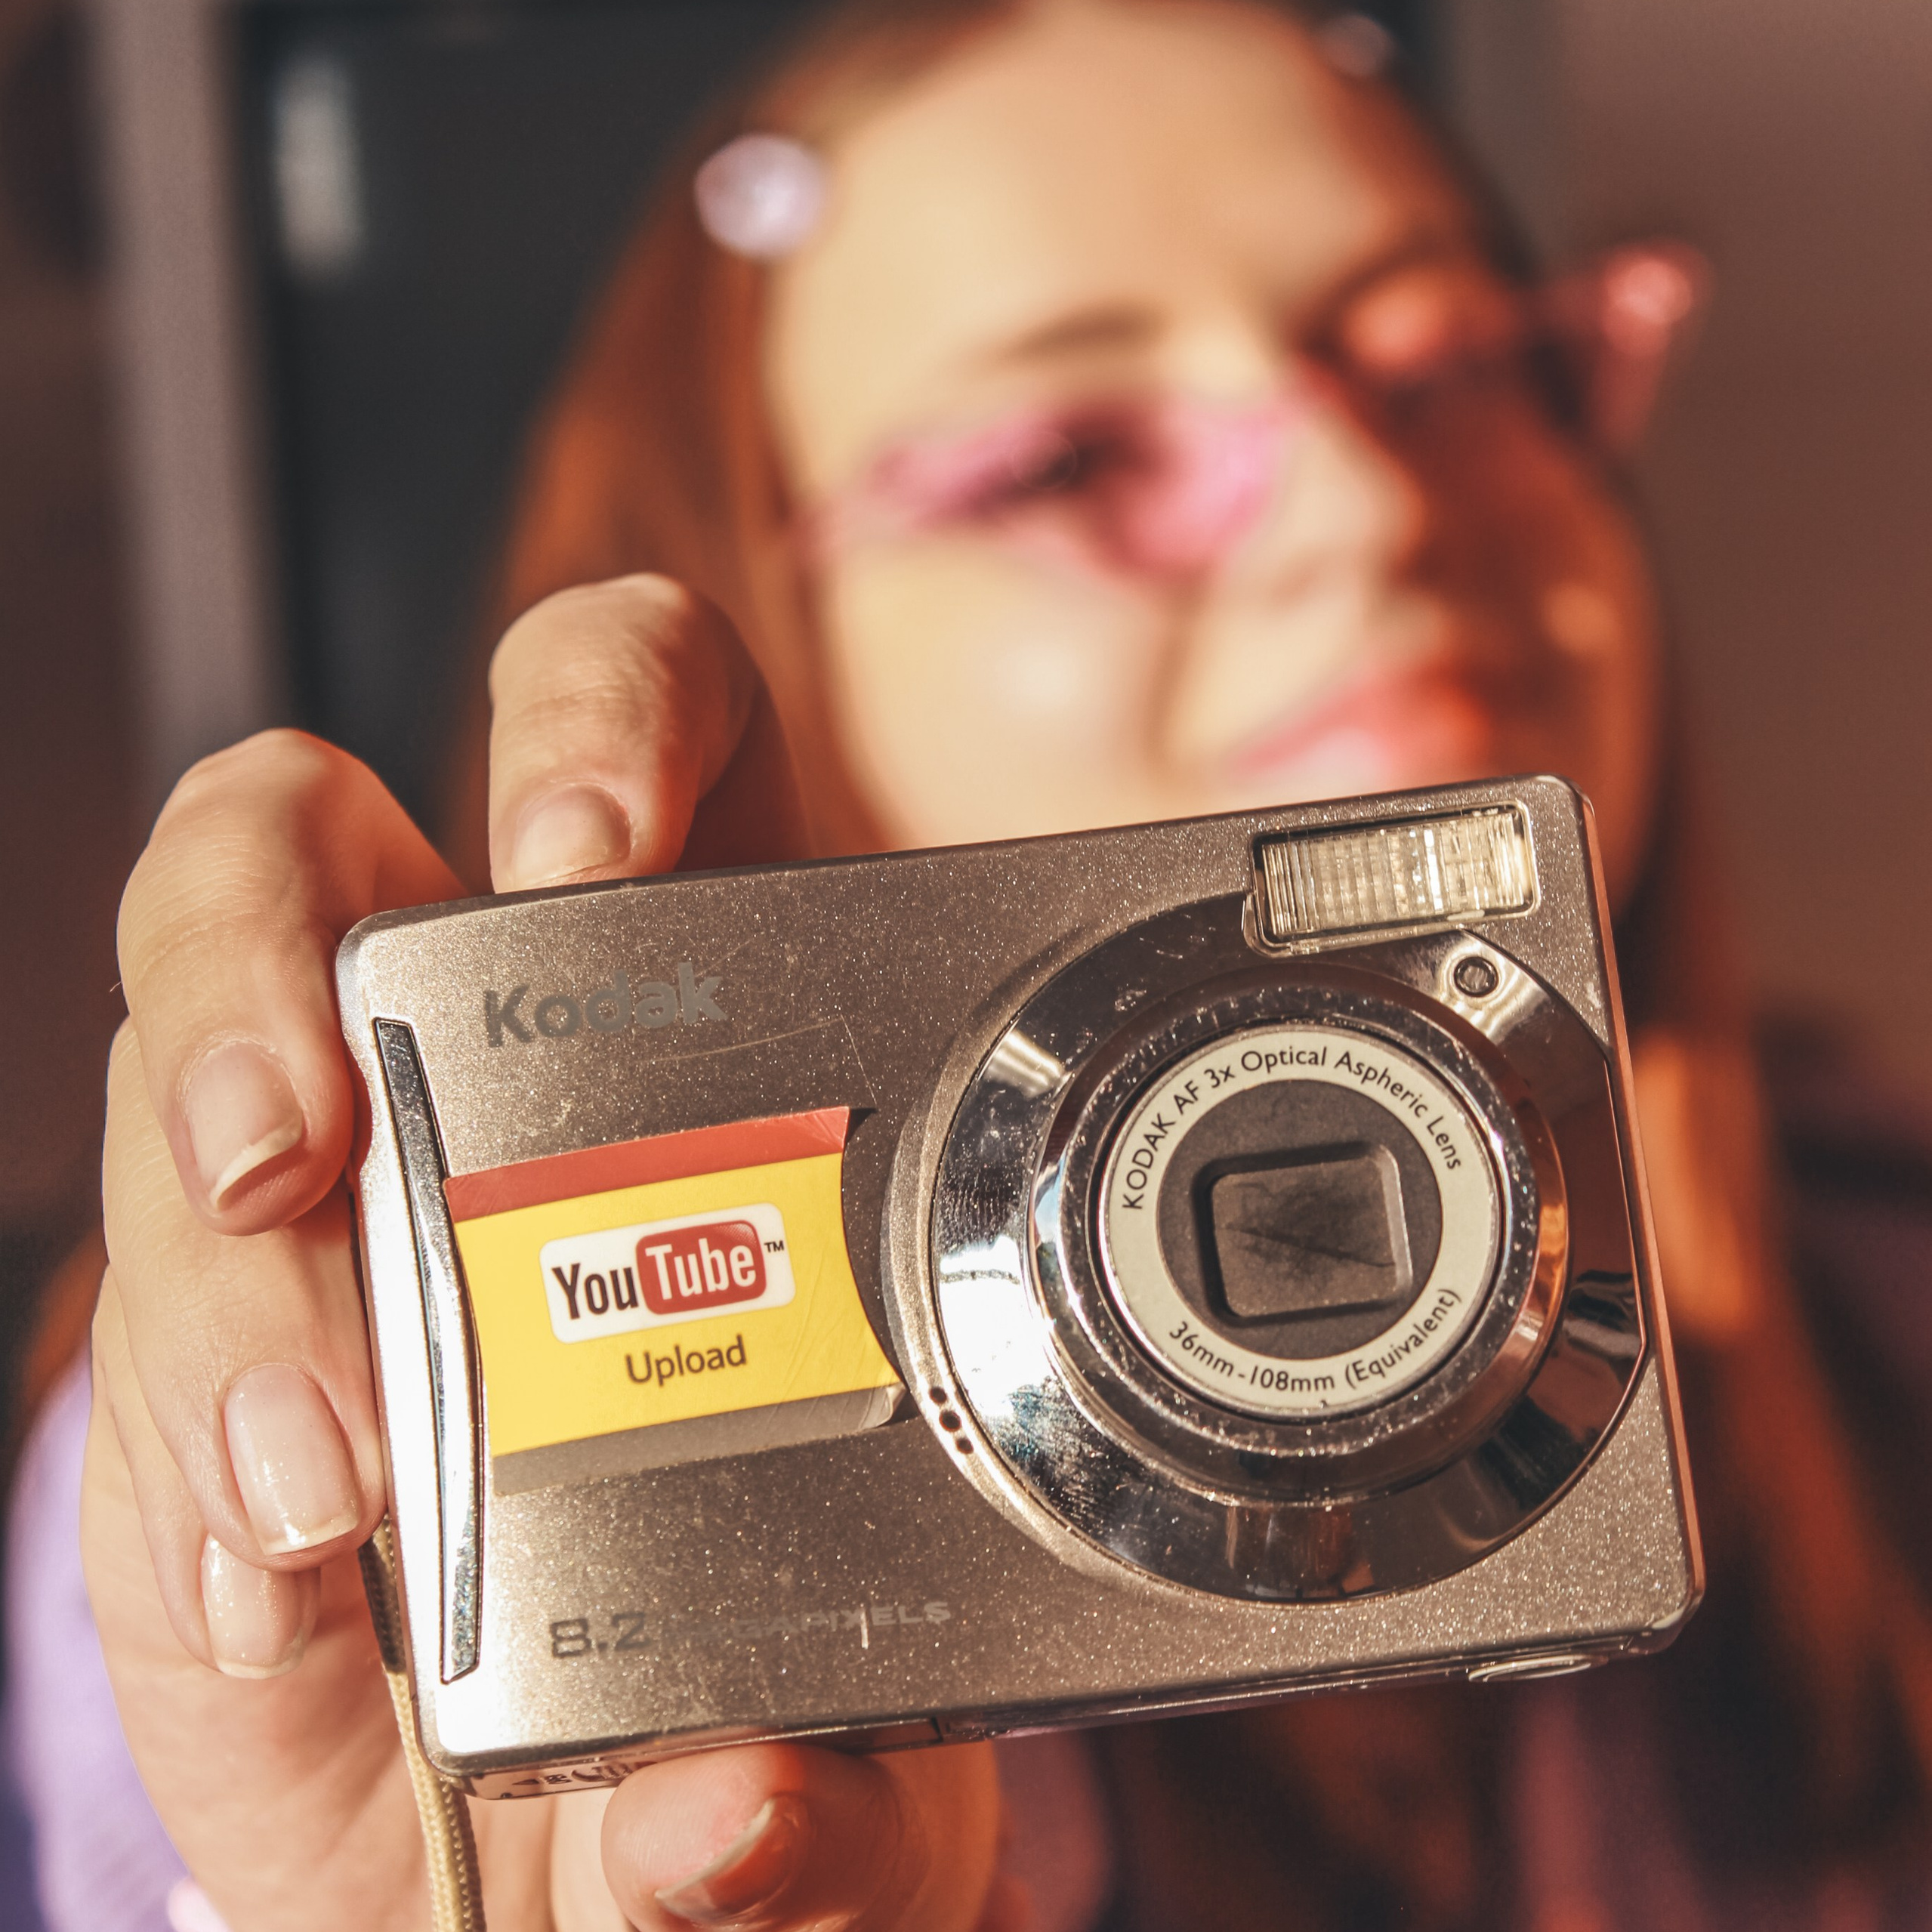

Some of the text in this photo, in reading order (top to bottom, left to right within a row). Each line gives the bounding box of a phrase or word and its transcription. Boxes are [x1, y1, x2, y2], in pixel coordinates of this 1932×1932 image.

[484, 961, 728, 1048] Kodak
[1122, 1045, 1462, 1209] KODAK AF 3x Optical Aspheric Lens
[551, 1237, 758, 1320] YouTube
[625, 1333, 748, 1387] Upload
[1344, 1288, 1462, 1390] (Equivalent)
[551, 1601, 952, 1658] 8.2 GAPIXELS
